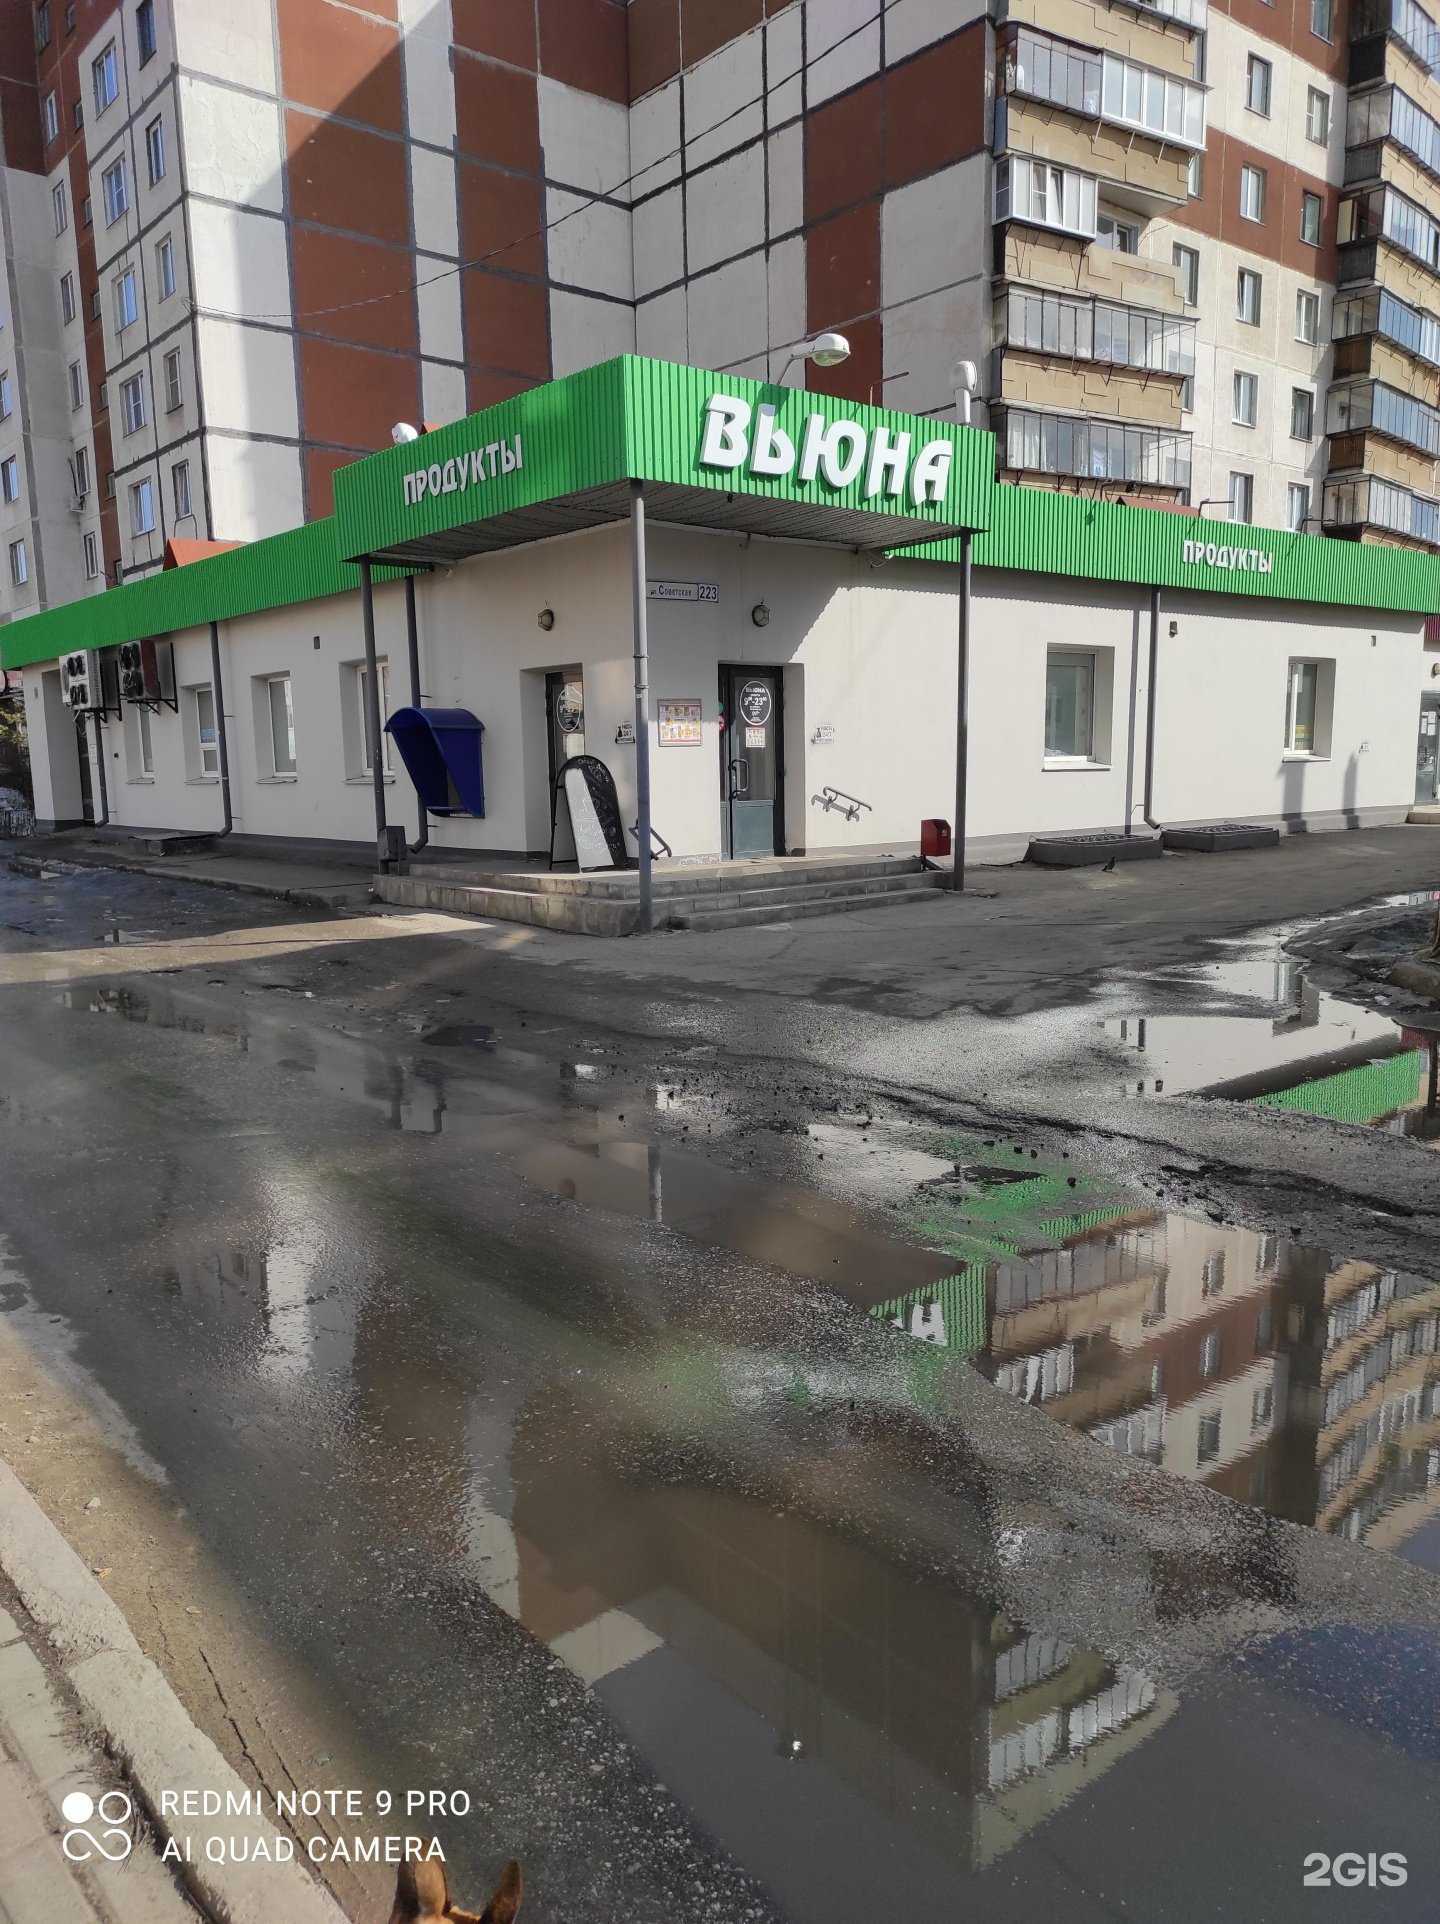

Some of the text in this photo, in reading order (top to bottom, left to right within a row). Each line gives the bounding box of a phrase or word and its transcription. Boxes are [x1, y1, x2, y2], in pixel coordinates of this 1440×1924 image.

[403, 434, 523, 506] ПРОДУКТЫ
[700, 393, 952, 506] ВЬЮНА
[1182, 539, 1273, 574] ПРОДУКТЫ
[700, 585, 717, 600] 223
